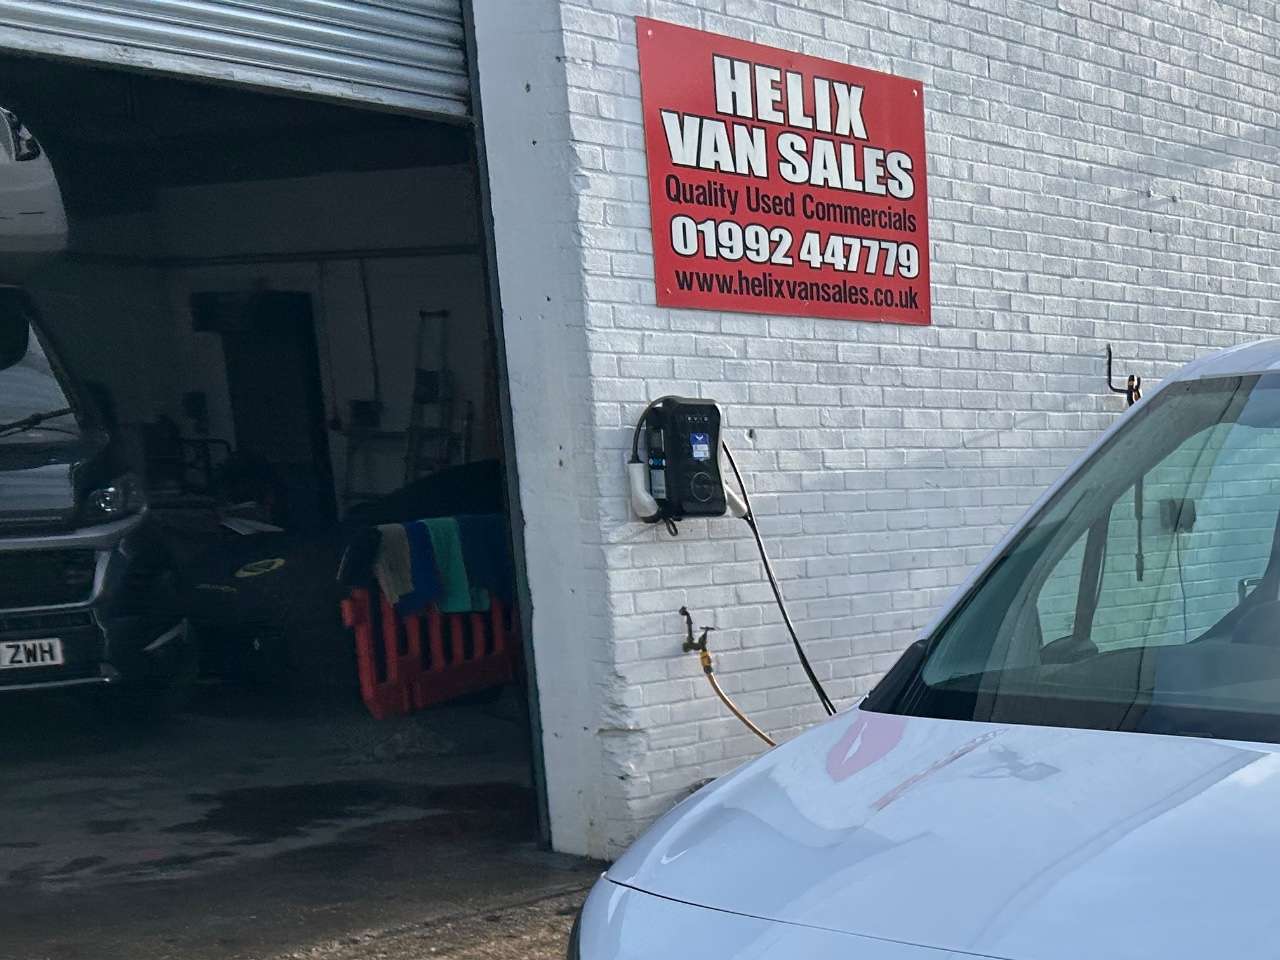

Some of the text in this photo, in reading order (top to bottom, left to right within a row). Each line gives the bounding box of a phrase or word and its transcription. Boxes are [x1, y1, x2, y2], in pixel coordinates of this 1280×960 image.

[713, 54, 868, 141] HELIX
[661, 109, 915, 199] VAN SALES
[665, 175, 916, 232] Quality Used Commercials
[670, 214, 920, 279] 01992 447779
[675, 269, 919, 310] www.helixvansales.co.uk
[5, 642, 55, 664] ZWH
